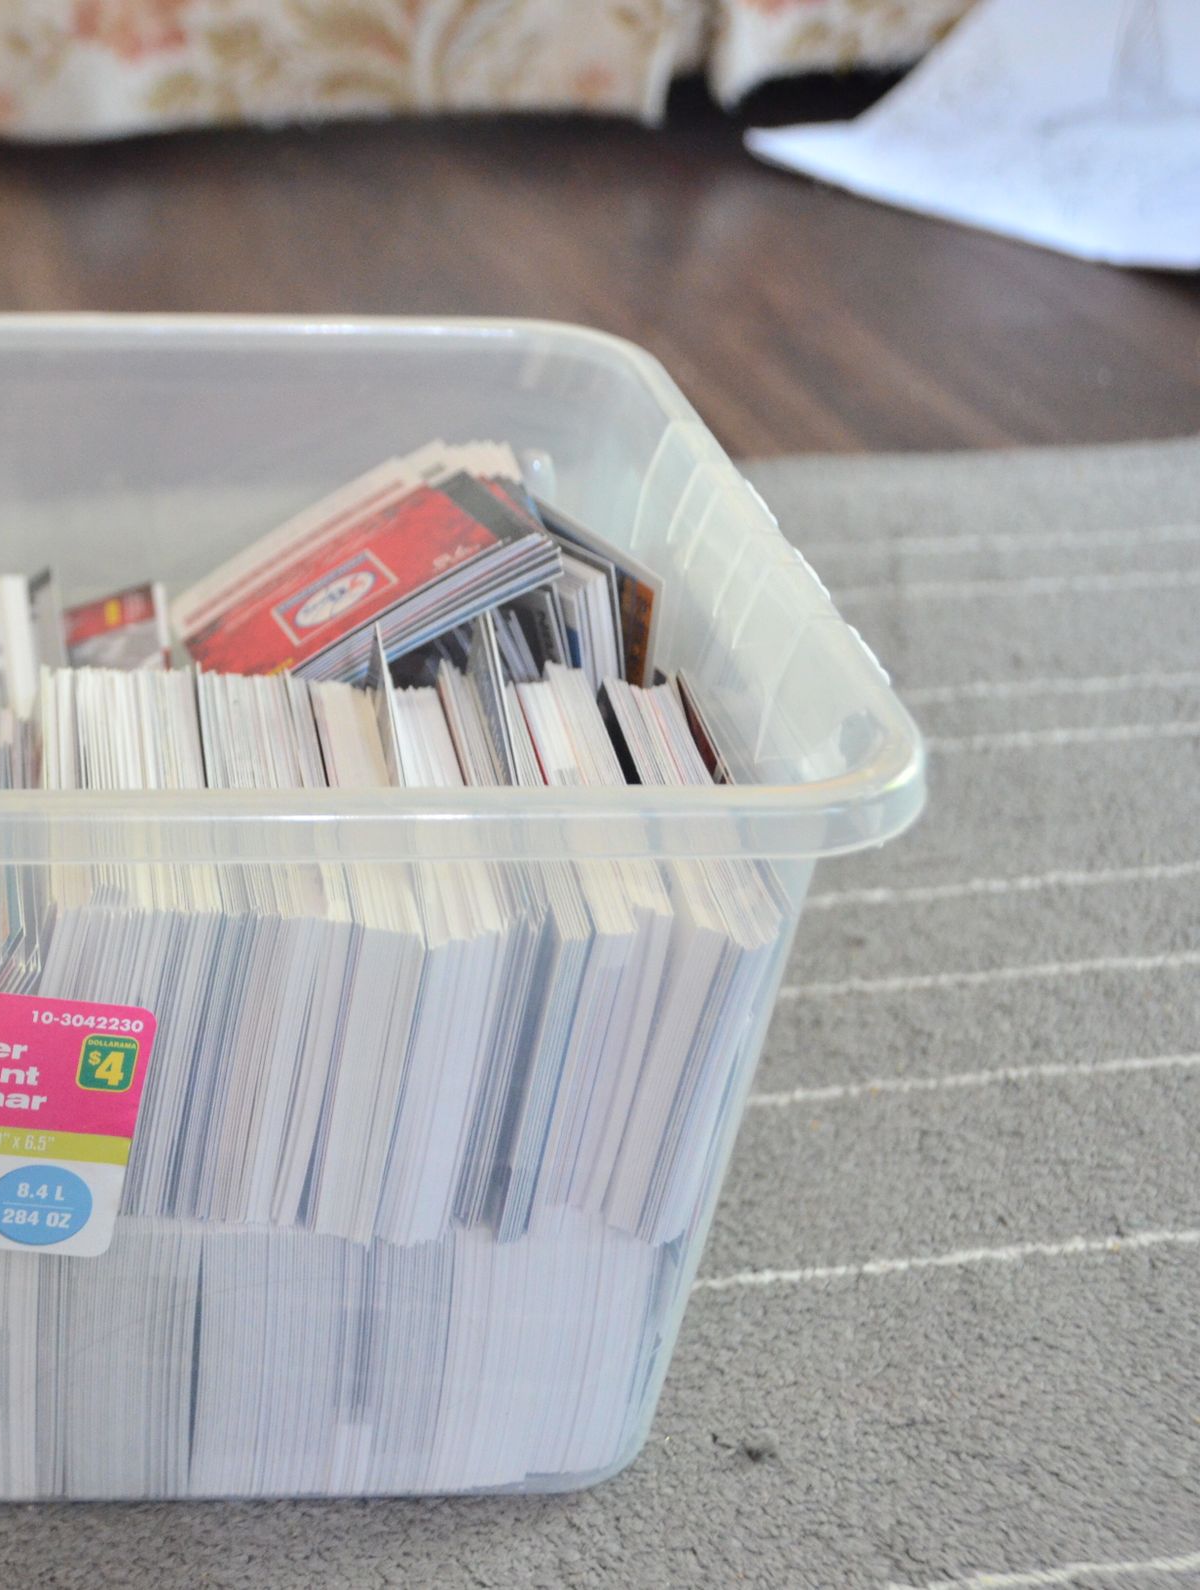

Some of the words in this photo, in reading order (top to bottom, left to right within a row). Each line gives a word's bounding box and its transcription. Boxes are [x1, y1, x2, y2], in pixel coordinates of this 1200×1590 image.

[32, 1010, 144, 1033] 10-3042230
[88, 1039, 137, 1050] DOLLARAMA
[88, 1050, 125, 1086] $4
[12, 1137, 20, 1149] x
[17, 1182, 49, 1199] 8.4
[55, 1185, 65, 1201] L
[2, 1208, 39, 1226] 284
[46, 1212, 73, 1229] OZ
